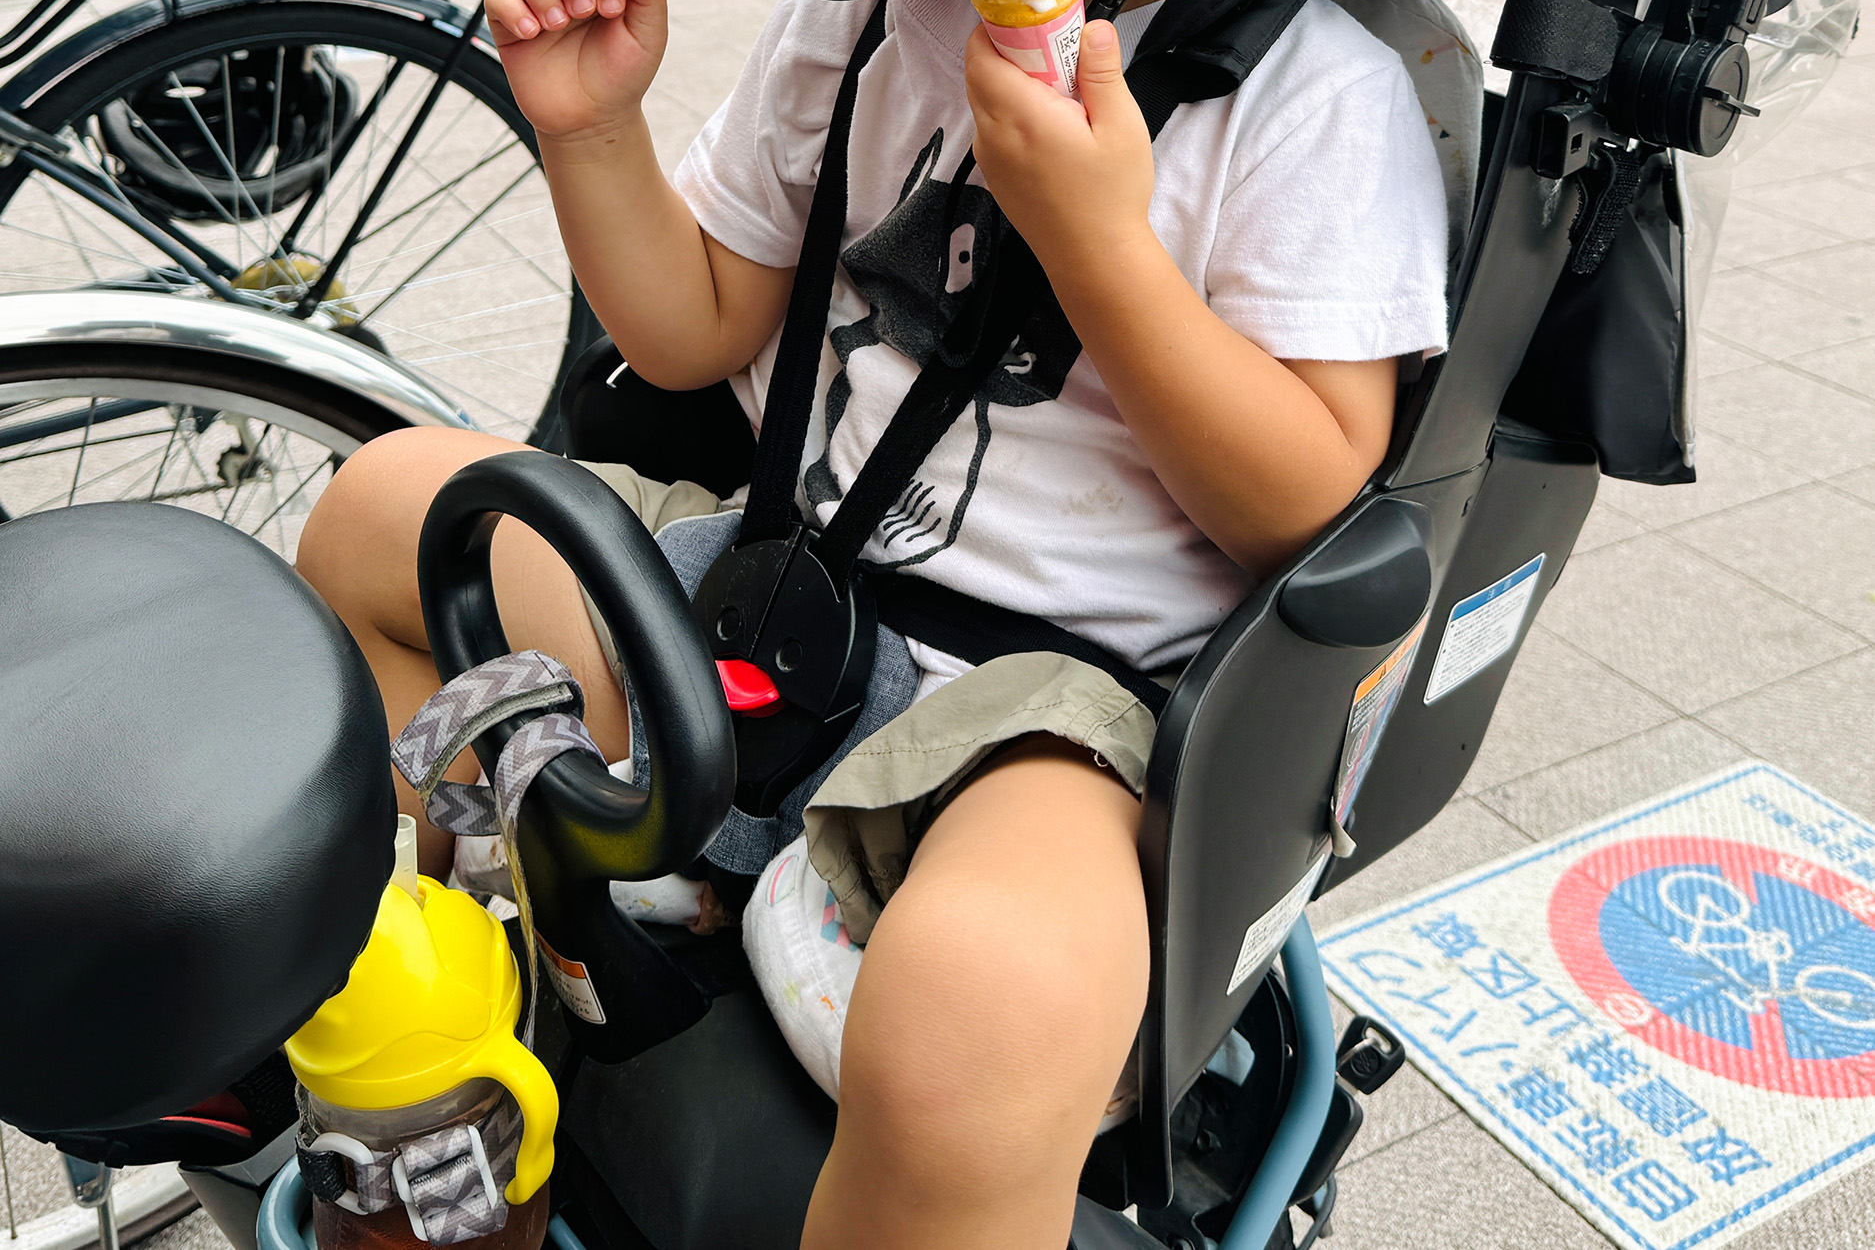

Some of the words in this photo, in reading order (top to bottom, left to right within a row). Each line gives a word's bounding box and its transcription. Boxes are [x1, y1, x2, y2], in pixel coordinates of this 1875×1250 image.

[1349, 950, 1699, 1222] 自転車・バイク
[1411, 912, 1772, 1186] 放置禁止区域
